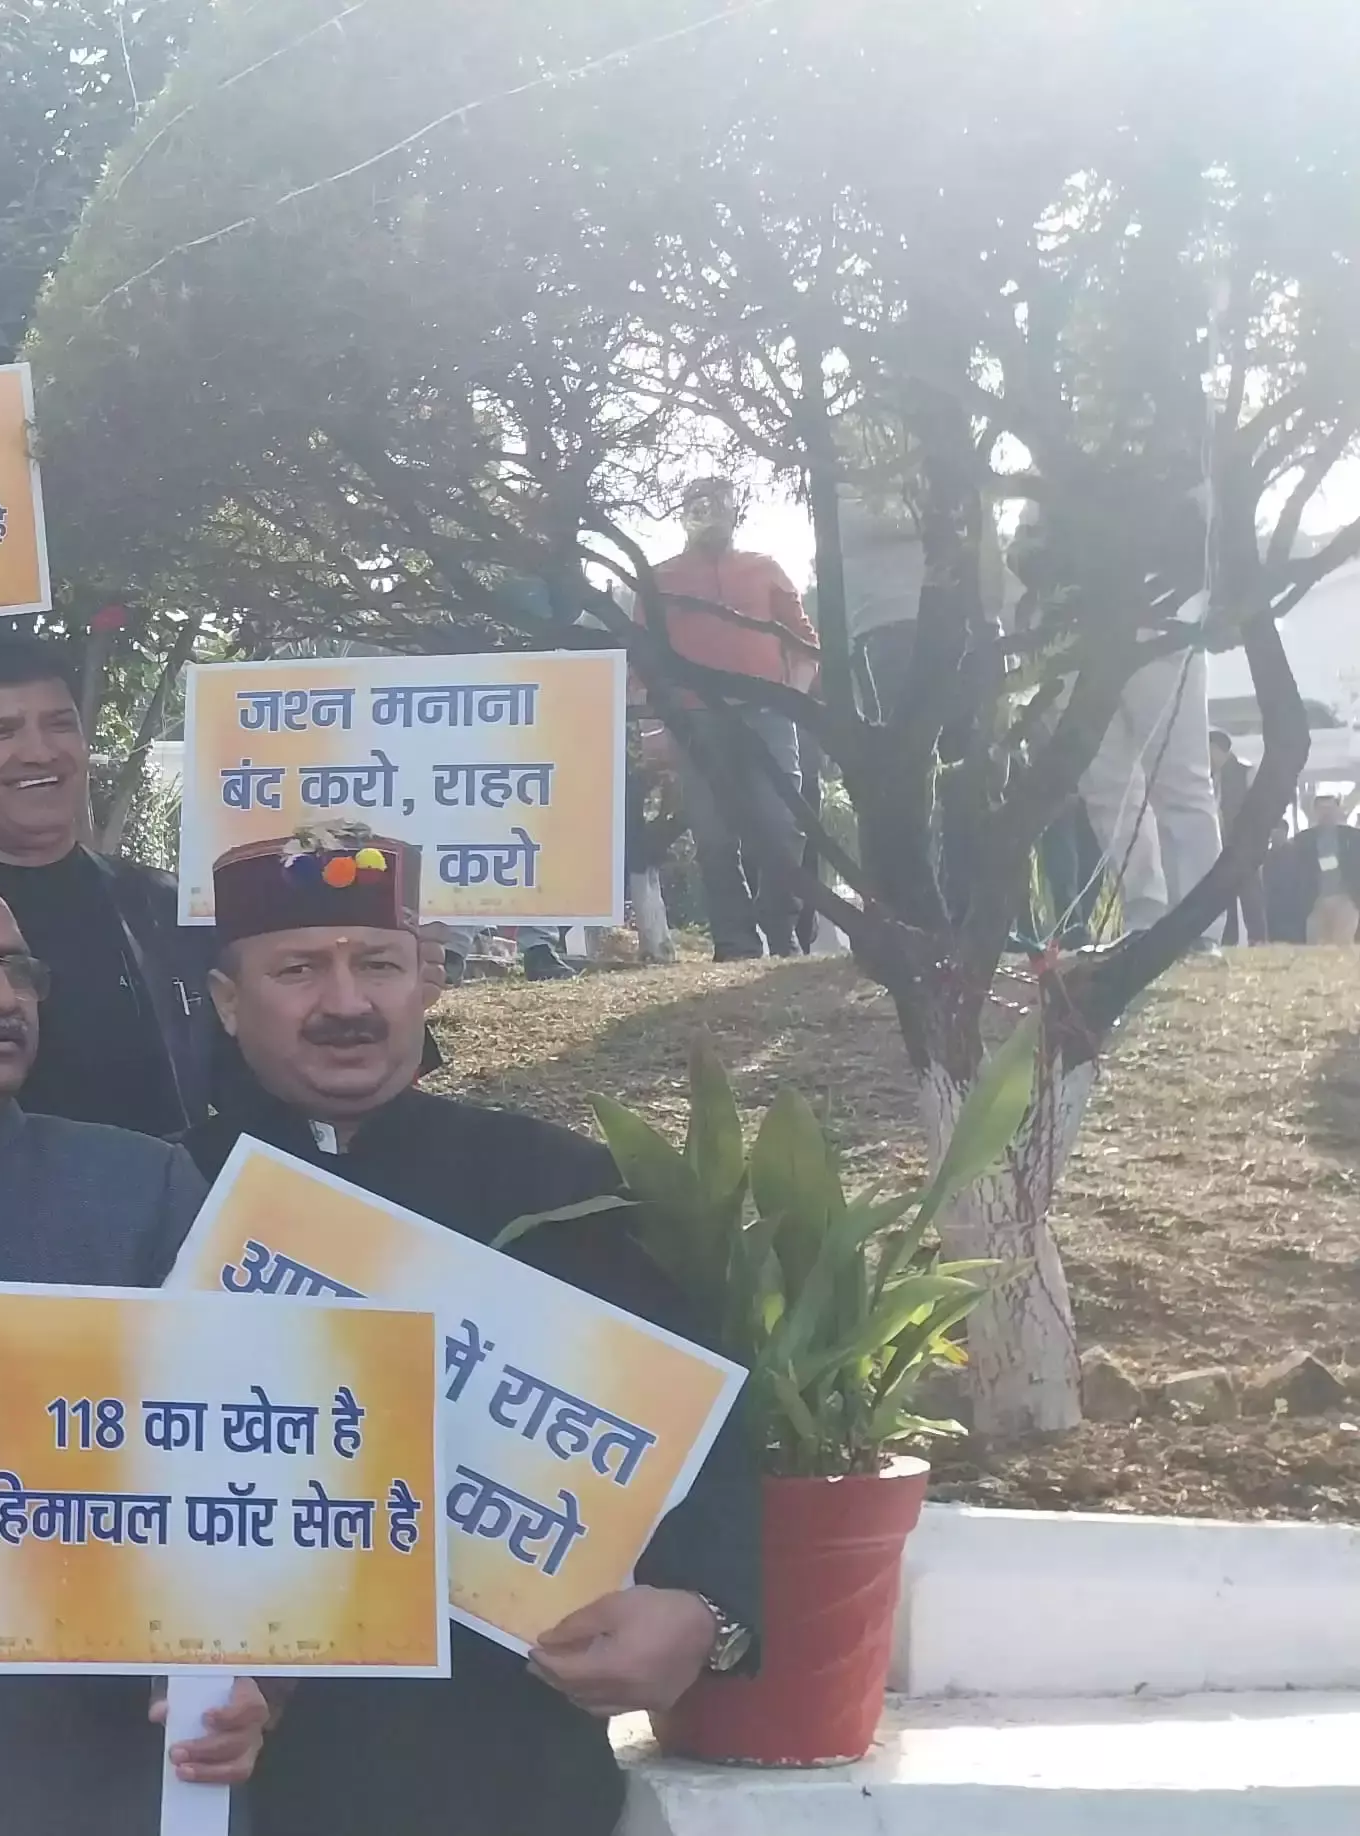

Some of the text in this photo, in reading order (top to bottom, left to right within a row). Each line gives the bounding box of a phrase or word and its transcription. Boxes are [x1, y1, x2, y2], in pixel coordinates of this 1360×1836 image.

[237, 683, 540, 732] जश्न मनाना
[220, 749, 555, 817] बंद करो, राहत
[436, 827, 540, 888] करो
[47, 1386, 365, 1459] 118 का खेल है
[488, 1364, 656, 1486] राहत
[186, 1482, 278, 1547] फॉर
[293, 1480, 375, 1549] सेल
[388, 1479, 421, 1553] है
[446, 1465, 586, 1577] करो
